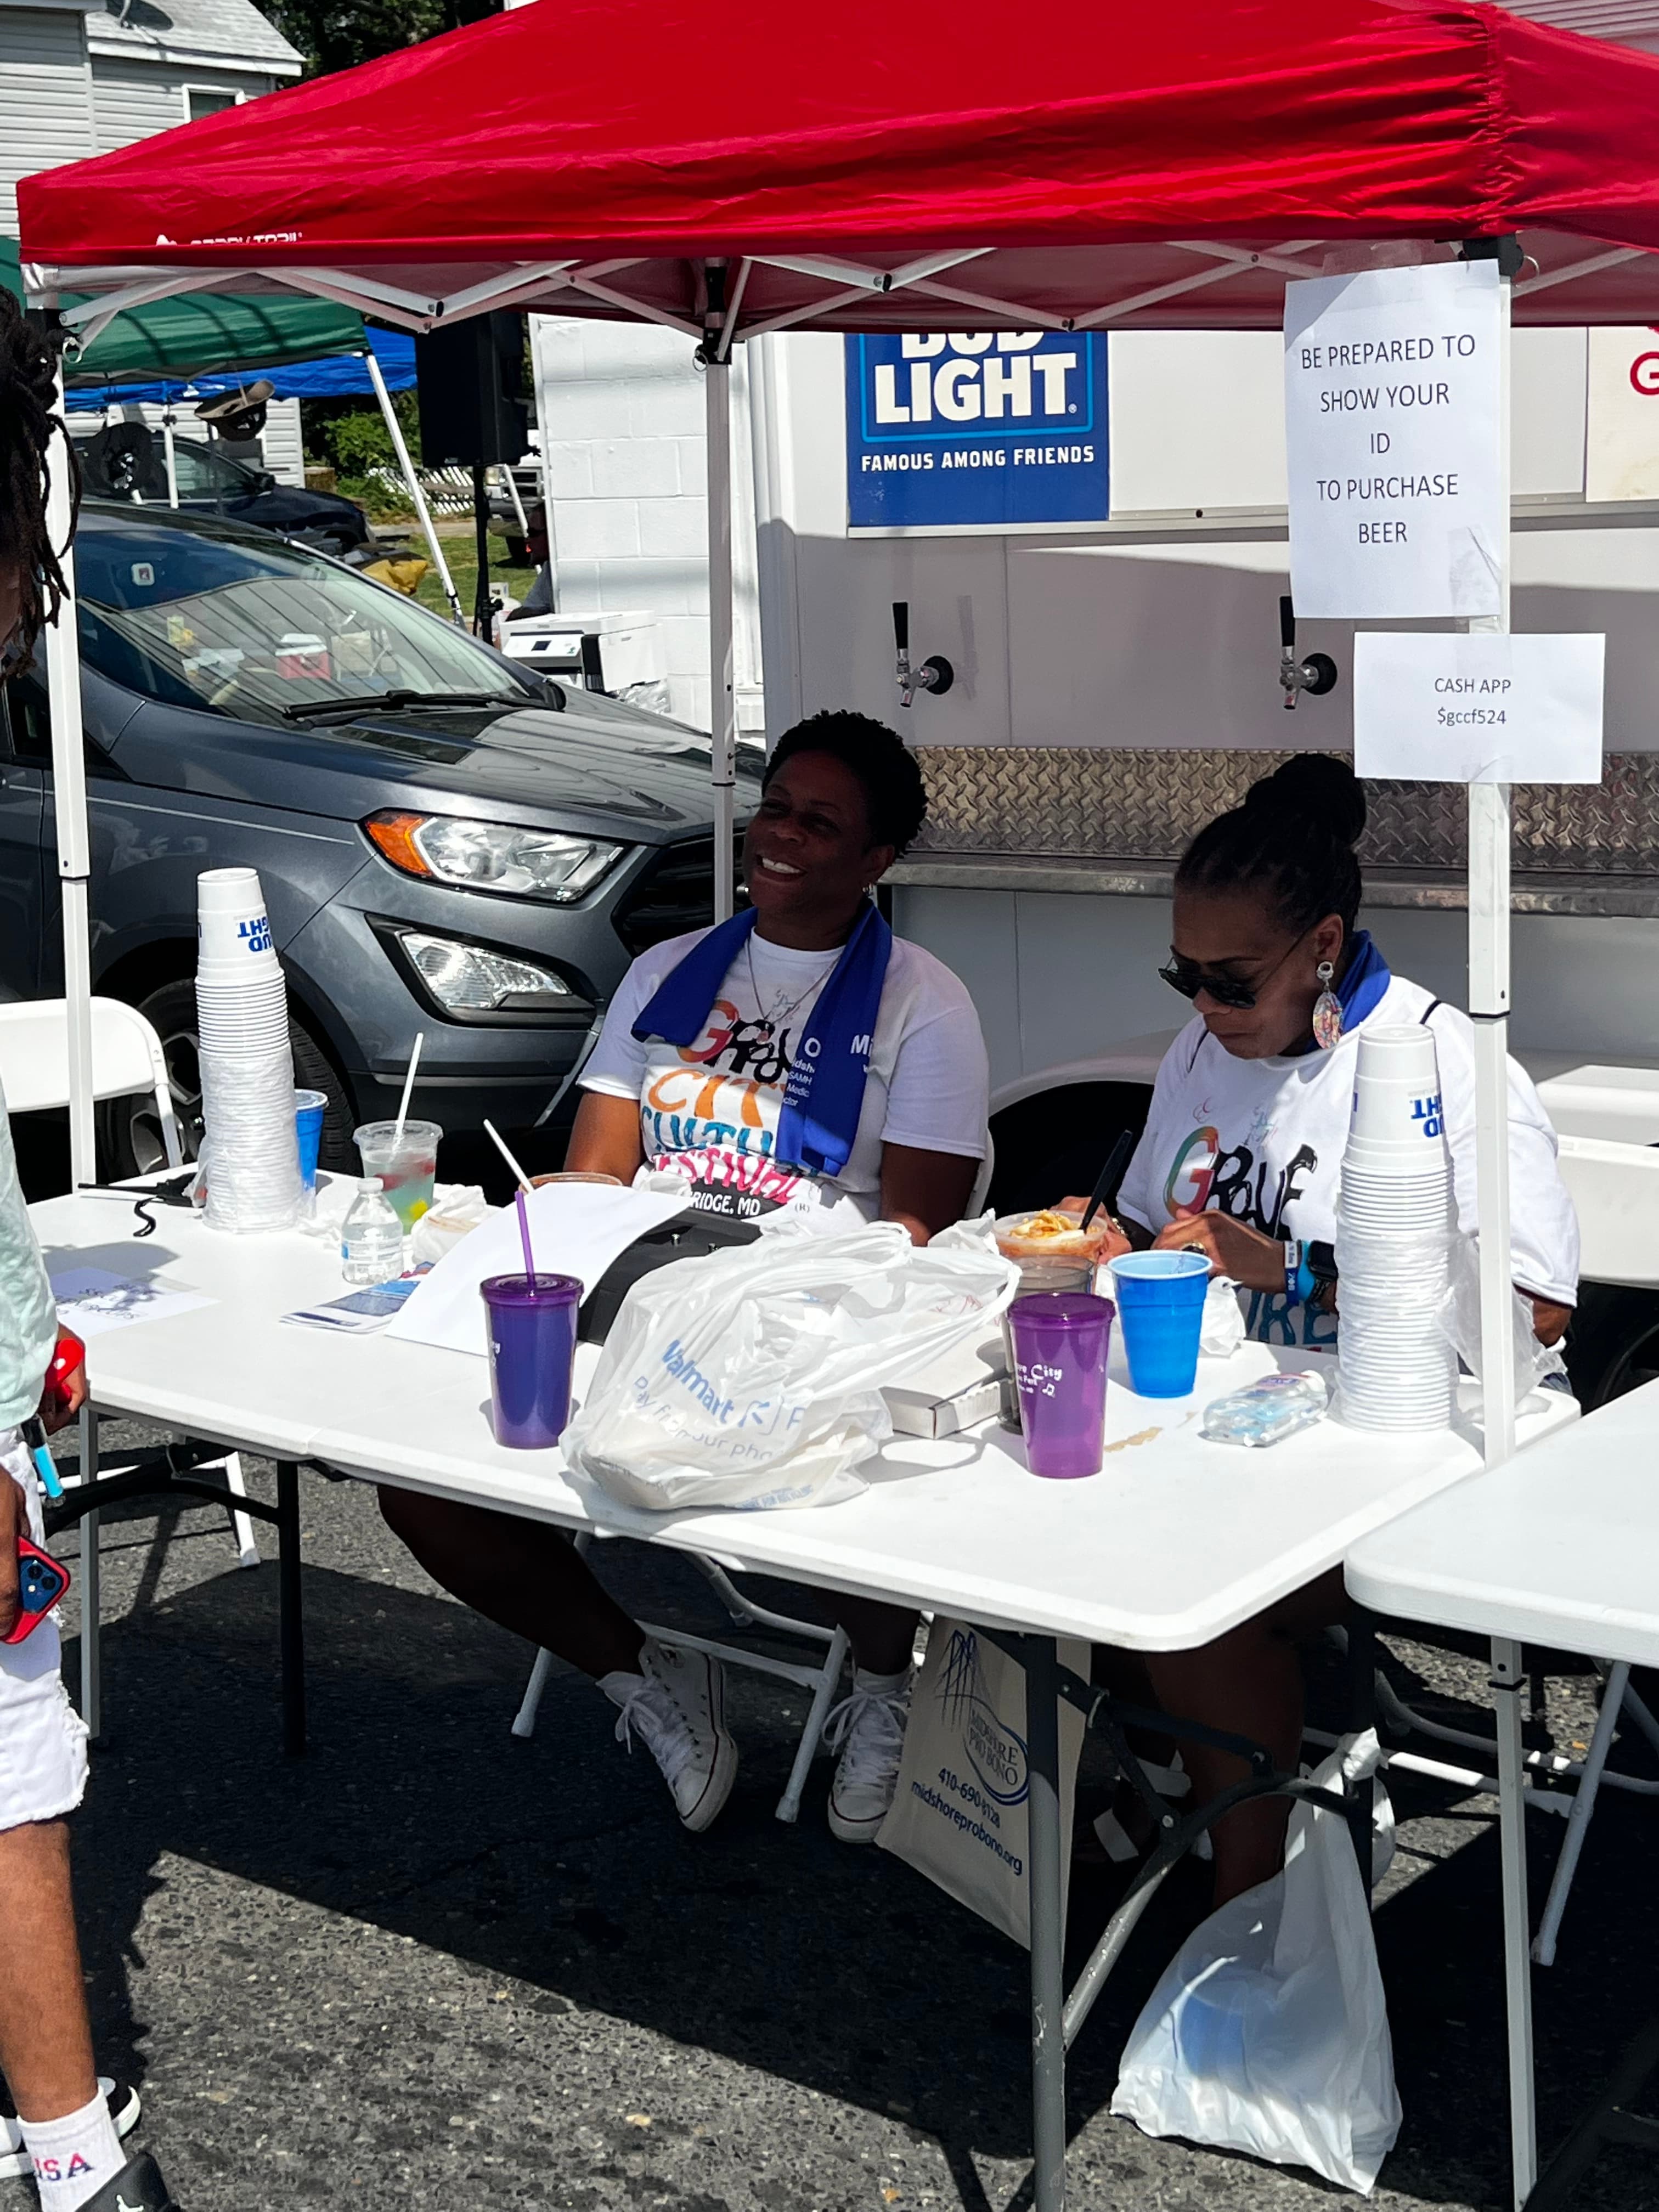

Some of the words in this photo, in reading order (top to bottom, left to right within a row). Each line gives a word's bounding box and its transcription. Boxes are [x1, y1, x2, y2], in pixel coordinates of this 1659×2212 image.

[1301, 347, 1322, 369] BE
[1329, 338, 1434, 366] PREPARED
[1441, 335, 1475, 358] TO
[875, 353, 1076, 424] LIGHT
[1321, 387, 1379, 412] SHOW
[1386, 383, 1449, 408] YOUR
[1371, 433, 1390, 454] ID
[861, 453, 933, 471] FAMOUS
[941, 449, 1006, 469] AMONG
[1014, 445, 1094, 466] FRIENDS
[1317, 479, 1340, 500] TO
[1347, 474, 1458, 500] PURCHASE
[1359, 522, 1407, 544] BEER
[1434, 678, 1474, 693] CASH
[1479, 679, 1511, 694] APP
[1437, 707, 1506, 726] $gccf524
[690, 1191, 734, 1215] RIDGE,
[737, 1197, 761, 1216] MD
